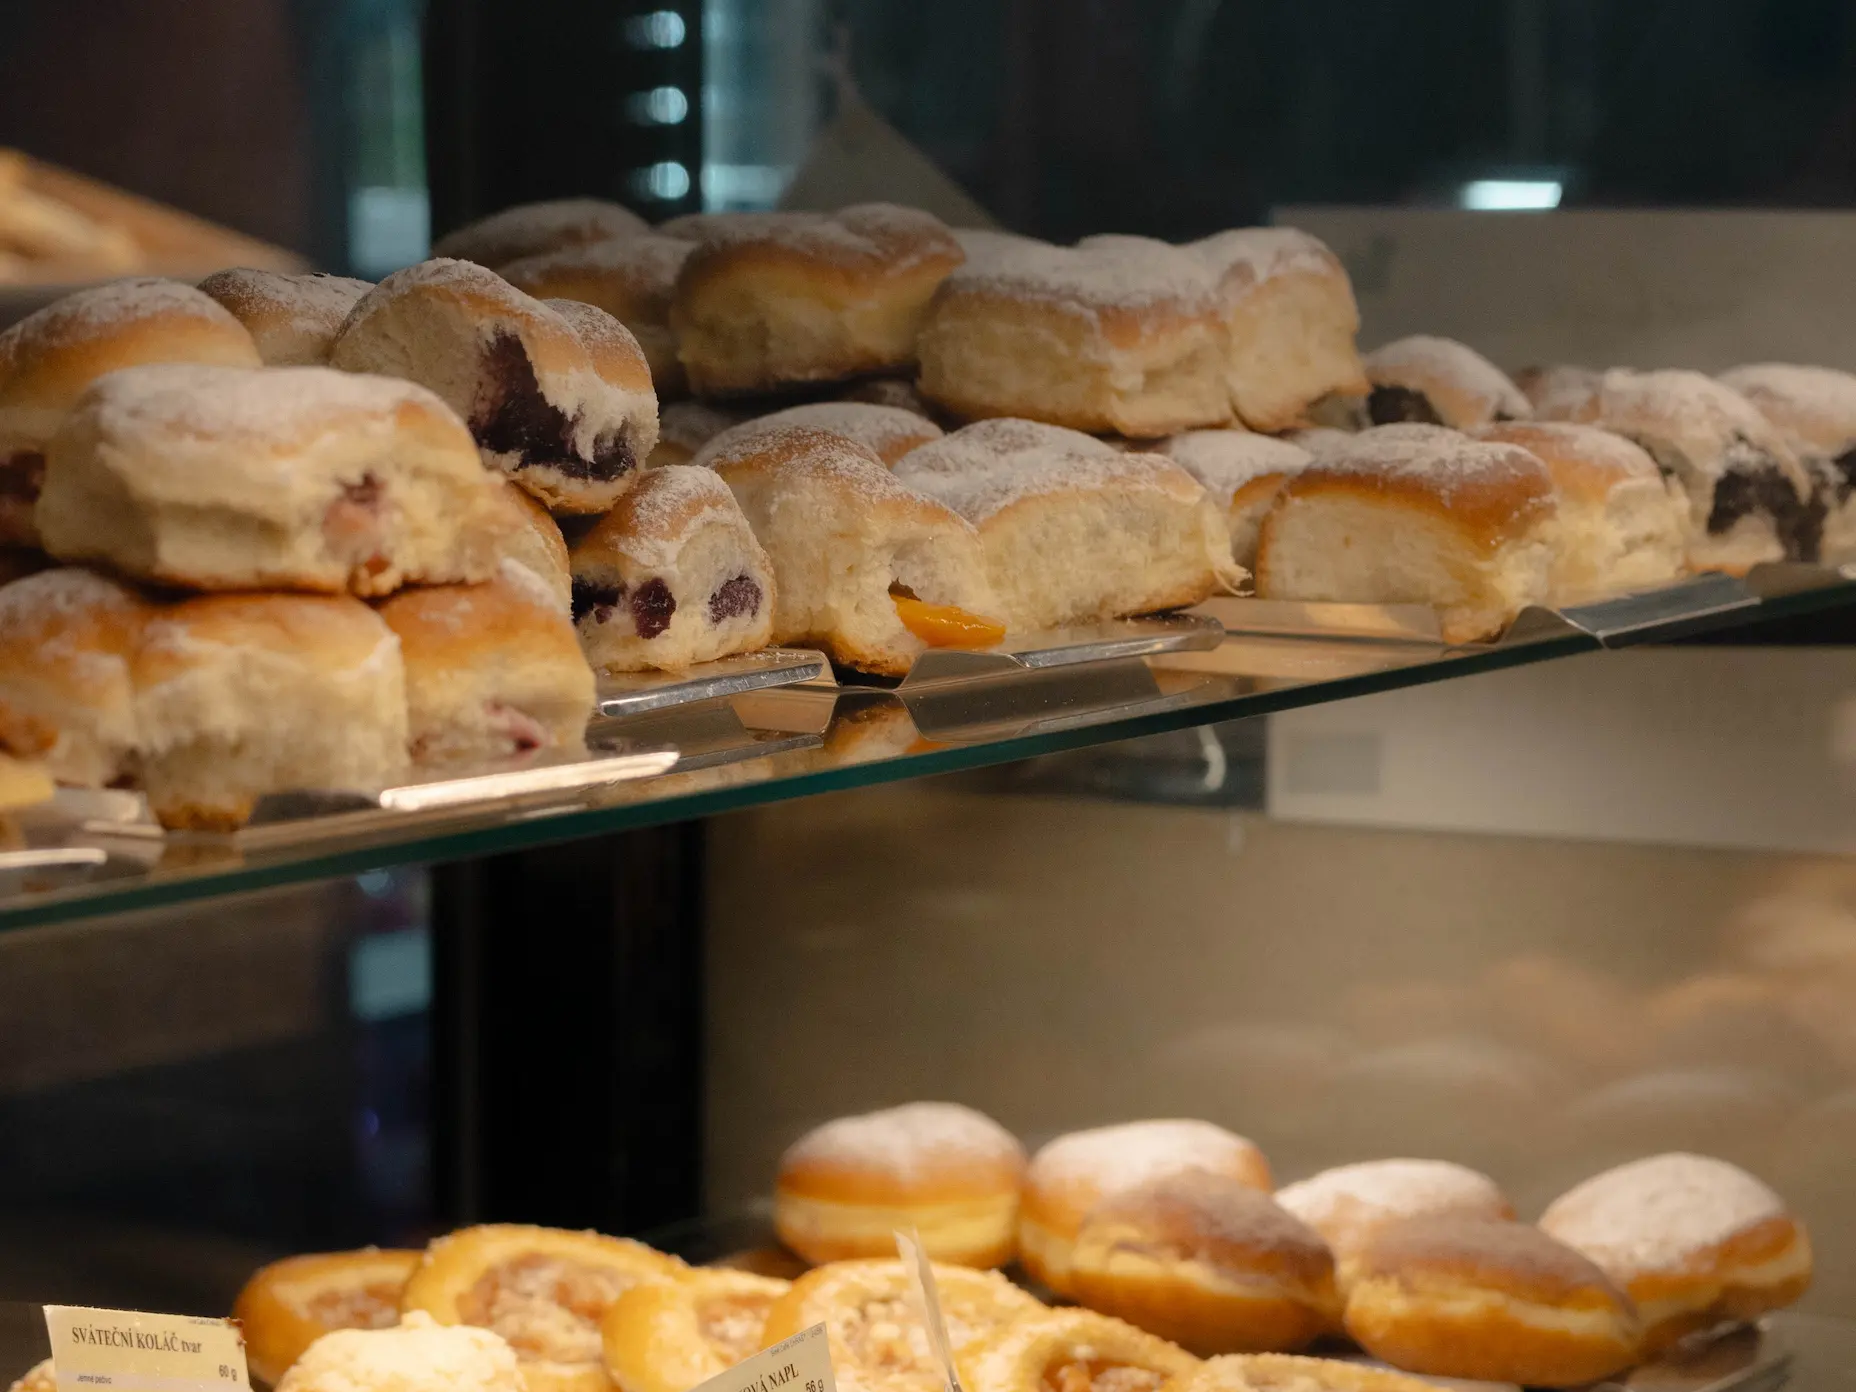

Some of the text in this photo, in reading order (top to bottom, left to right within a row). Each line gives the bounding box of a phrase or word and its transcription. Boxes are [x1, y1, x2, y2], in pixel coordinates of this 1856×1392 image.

[72, 1324, 134, 1347] SVÁTEČNÍ
[136, 1331, 178, 1352] KOLÁČ
[219, 1365, 237, 1381] 60 g
[769, 1363, 800, 1392] NAPL
[818, 1378, 825, 1392] g
